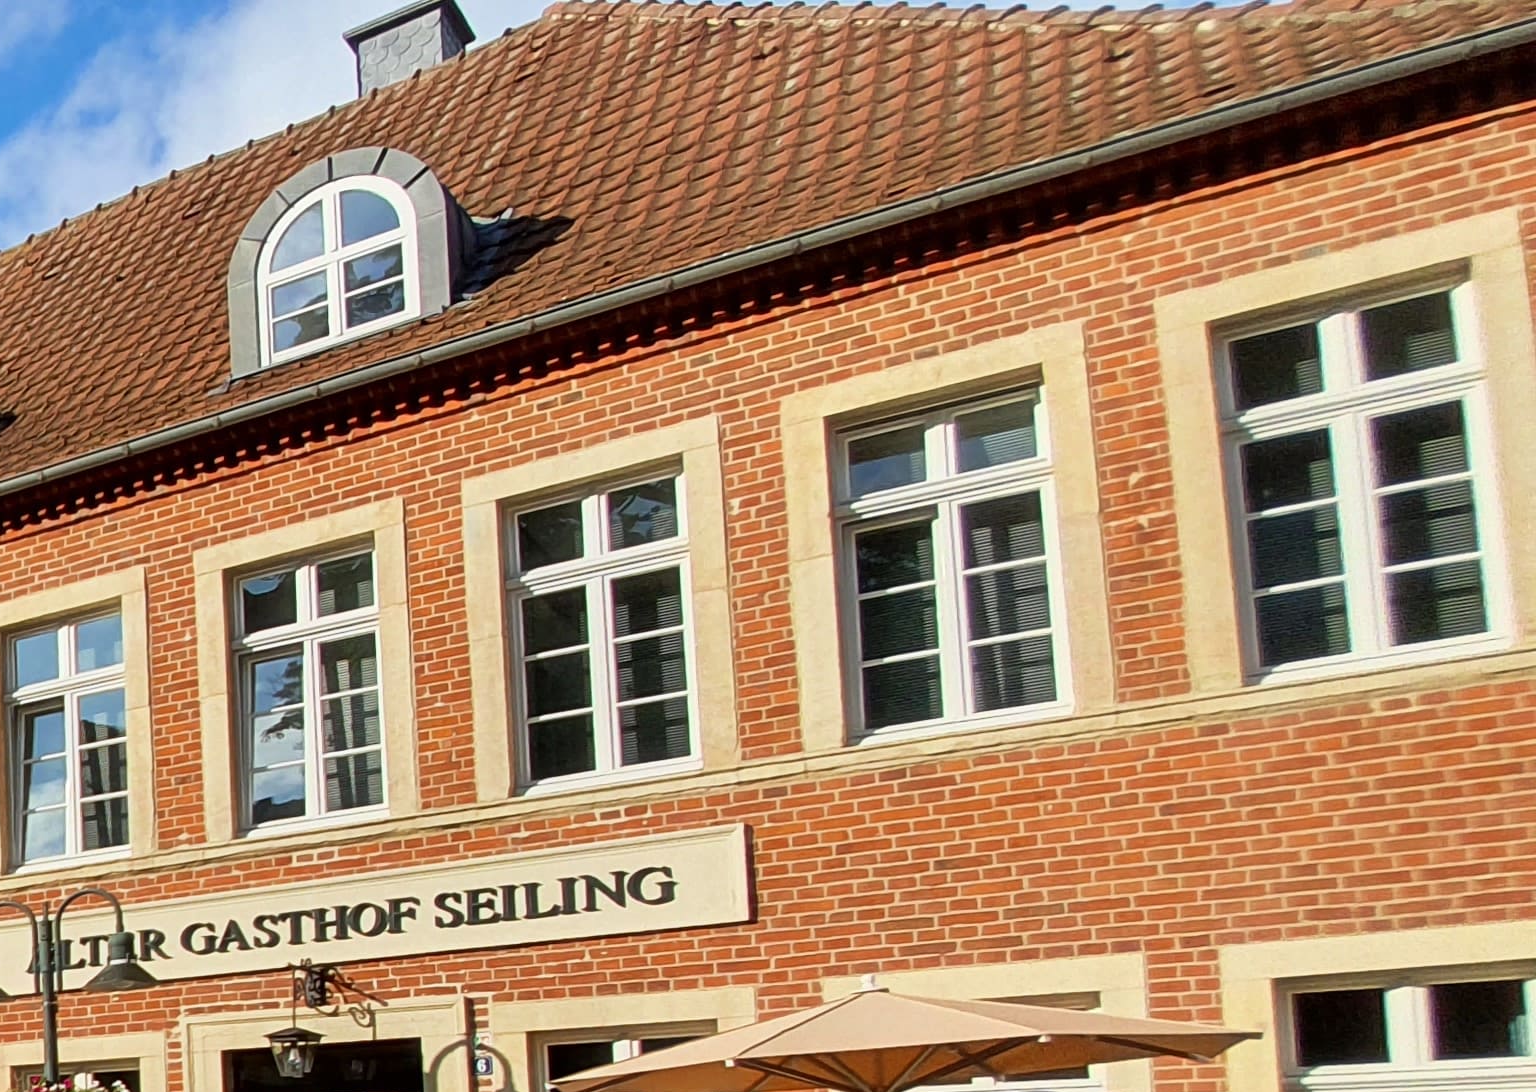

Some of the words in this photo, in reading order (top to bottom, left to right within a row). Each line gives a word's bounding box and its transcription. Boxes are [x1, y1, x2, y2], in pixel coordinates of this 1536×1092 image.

[25, 928, 173, 974] LTR
[180, 896, 421, 955] GASTHOF
[435, 865, 679, 929] SEILING
